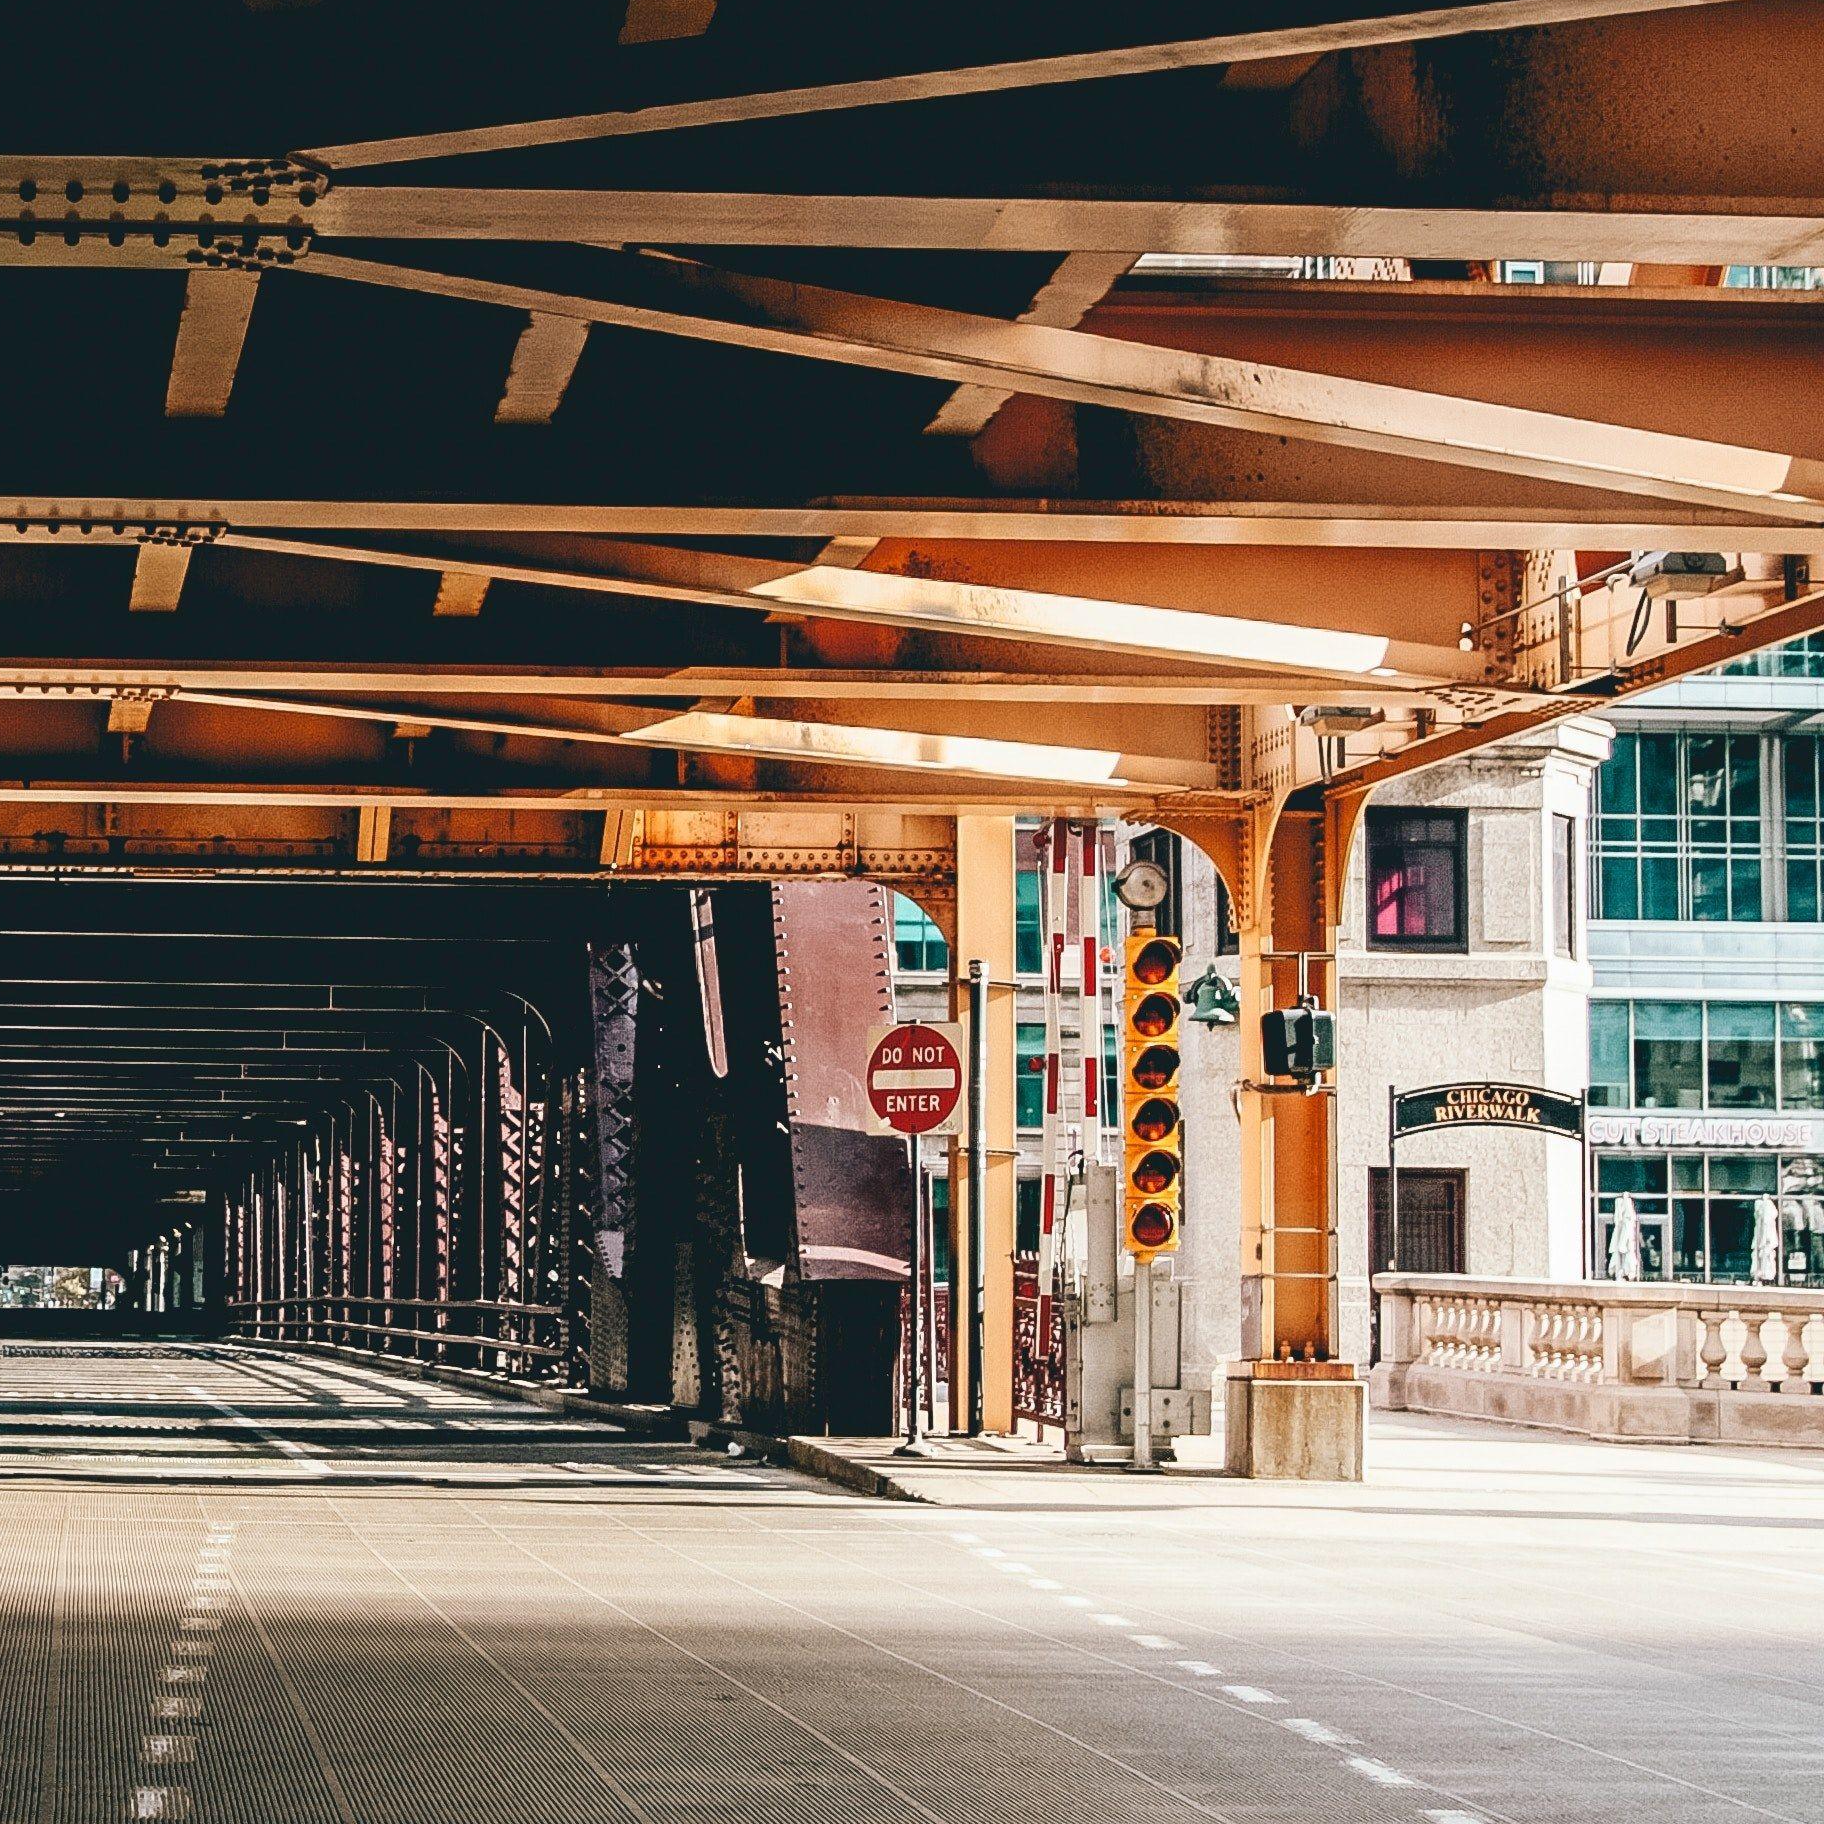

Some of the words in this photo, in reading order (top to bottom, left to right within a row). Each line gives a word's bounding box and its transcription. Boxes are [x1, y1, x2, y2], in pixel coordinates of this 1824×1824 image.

[882, 1047, 903, 1064] DO
[912, 1046, 945, 1063] NOT
[886, 1094, 941, 1112] ENTER
[1446, 1089, 1530, 1106] CHICAGO
[1434, 1103, 1542, 1124] RIVERWALK
[1588, 1118, 1639, 1143] CUT
[1642, 1119, 1810, 1145] STEAKHOUSE
